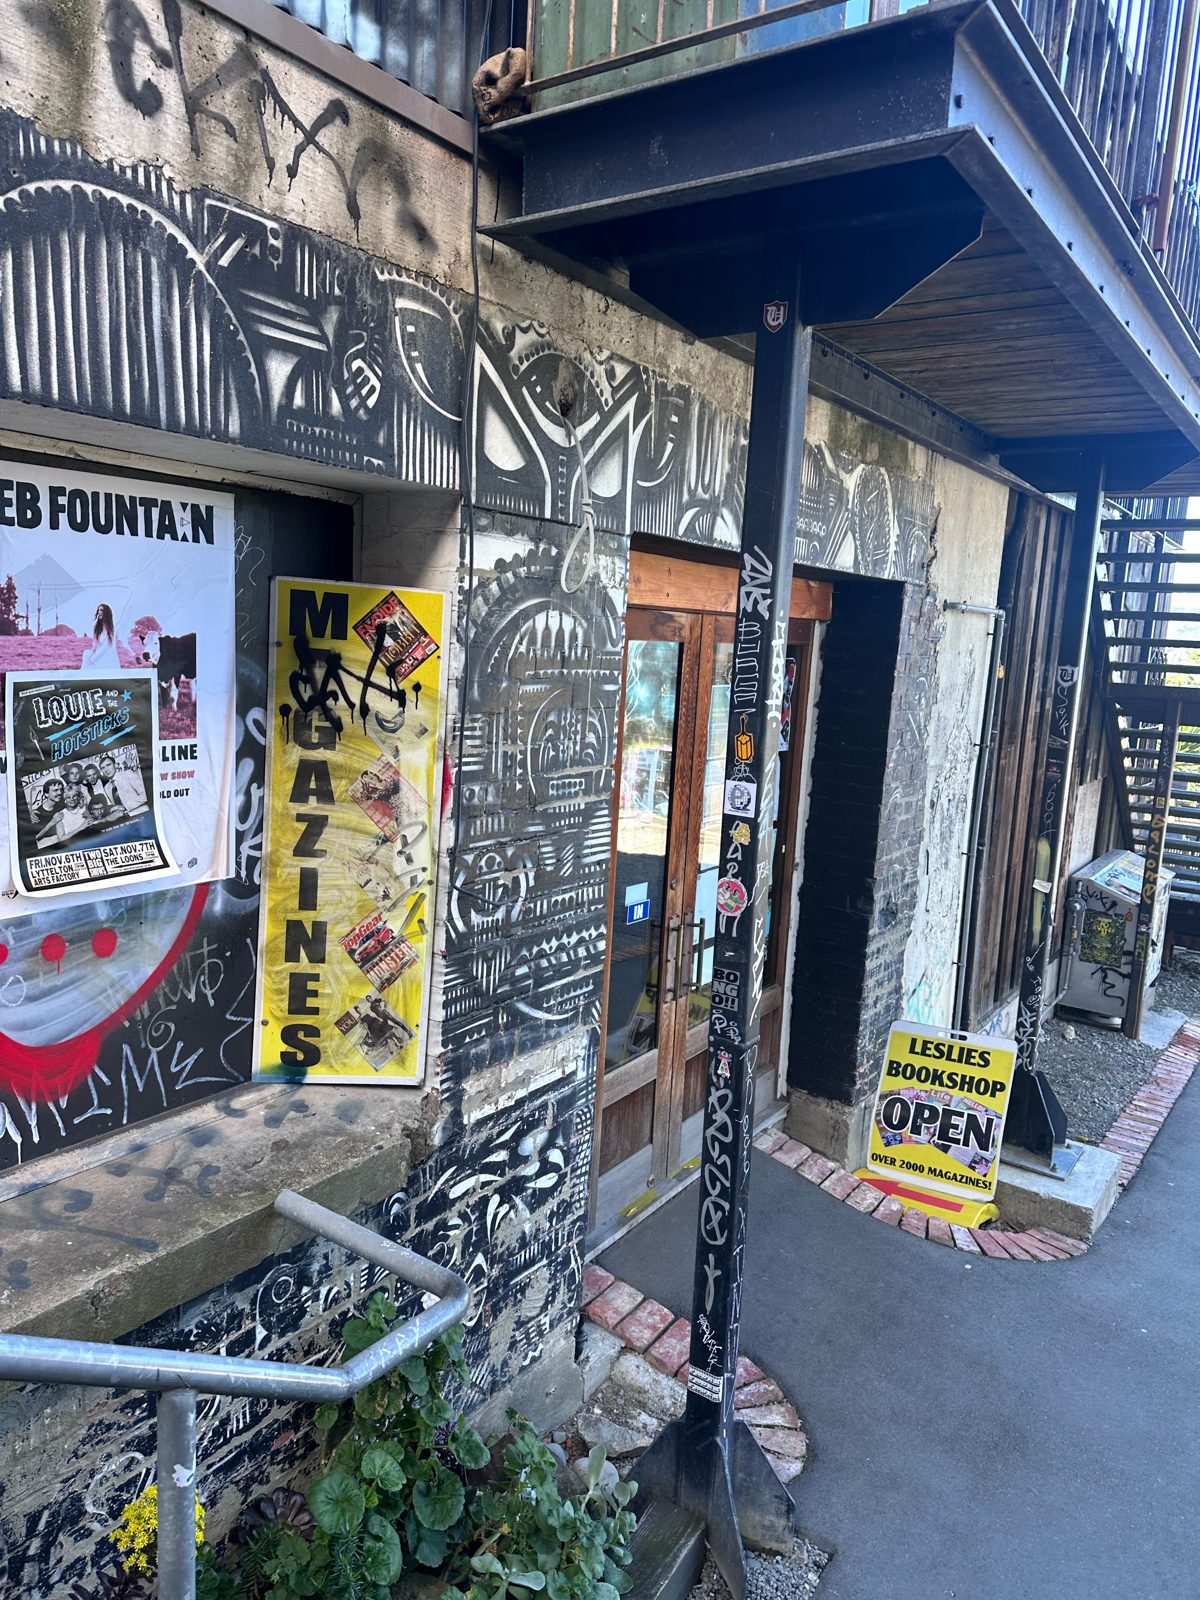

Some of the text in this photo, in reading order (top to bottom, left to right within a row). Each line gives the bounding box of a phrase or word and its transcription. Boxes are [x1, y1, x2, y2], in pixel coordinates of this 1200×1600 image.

[32, 688, 107, 728] LOUIE
[105, 689, 119, 698] AND
[106, 699, 118, 708] THE
[50, 706, 130, 762] HOTSTICKS
[159, 744, 198, 762] LINE
[171, 769, 195, 781] SHOW
[173, 788, 190, 798] OUT
[84, 850, 102, 861] TWO
[103, 841, 156, 858] SAT.NOV.7TH
[29, 852, 82, 870] FRI.NOV.6TH
[87, 859, 103, 869] BIG
[105, 857, 120, 866] THE
[121, 853, 144, 864] LOONS
[30, 864, 75, 879] LYTTELTON
[33, 872, 80, 887] ARTS FACTORY
[633, 903, 644, 920] IN
[713, 968, 739, 984] BO
[712, 980, 739, 997] NG
[909, 1037, 991, 1068] LESLIES
[886, 1059, 1006, 1098] BOOKSHOP
[881, 1095, 995, 1153] OPEN
[871, 1152, 993, 1191] OVER 2000 MAGAZINES!
